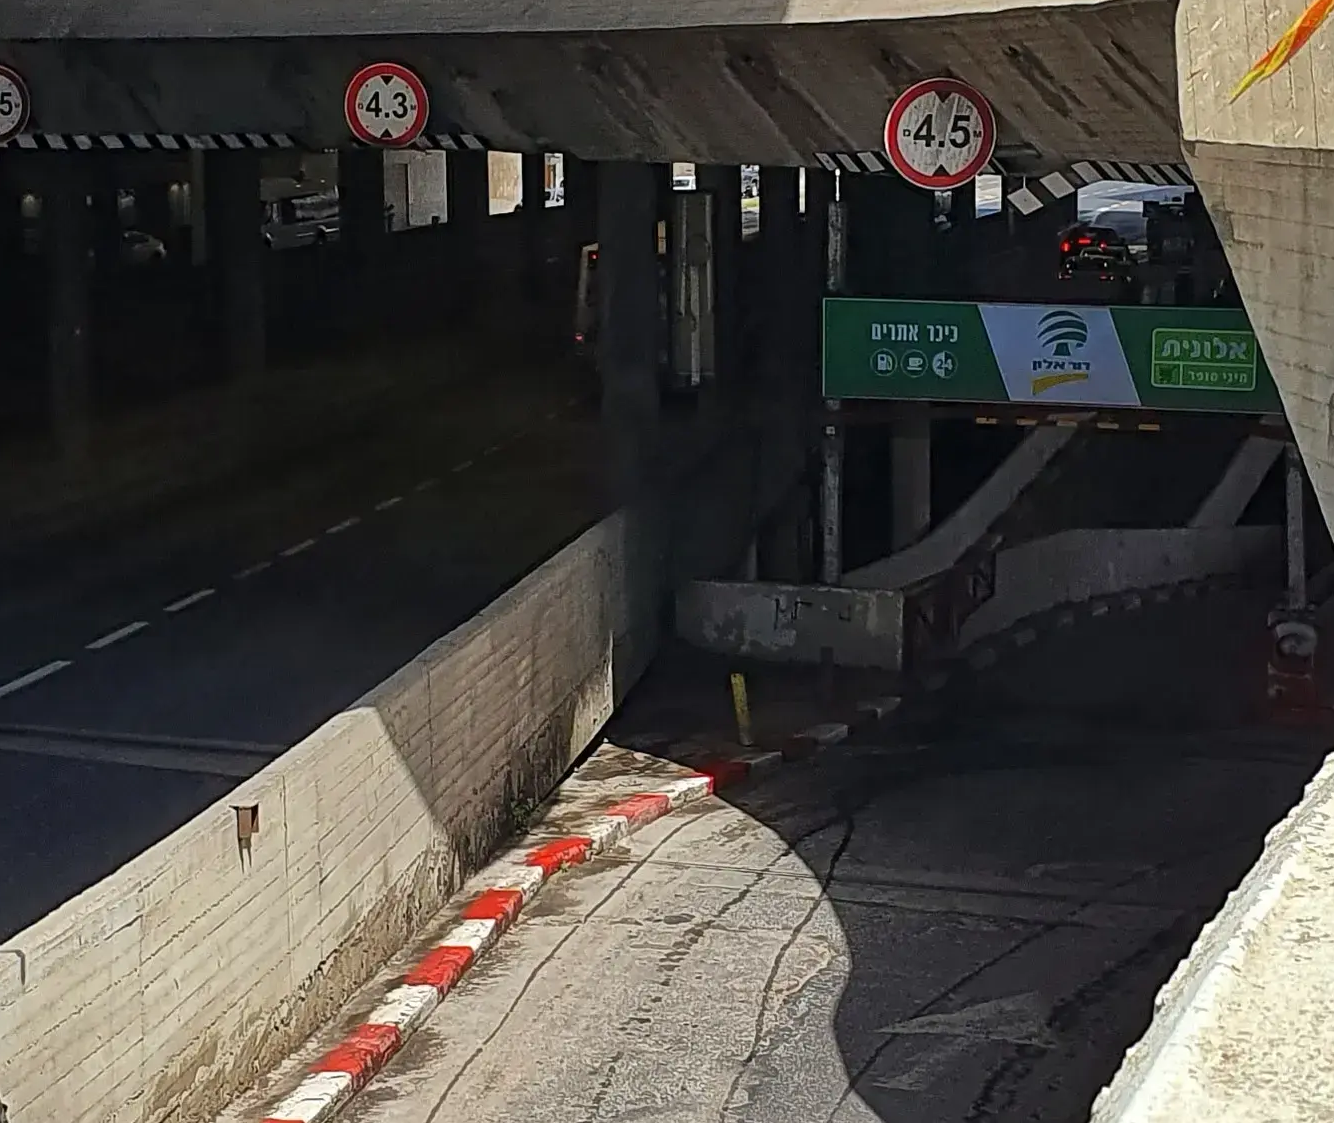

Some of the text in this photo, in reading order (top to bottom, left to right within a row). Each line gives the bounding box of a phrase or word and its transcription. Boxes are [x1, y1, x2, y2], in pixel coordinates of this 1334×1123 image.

[365, 91, 409, 119] 4.3
[913, 113, 971, 149] 4.5
[871, 322, 959, 343] כיכר אתרים
[1160, 336, 1248, 361] אלונית
[1032, 358, 1066, 372] אלון
